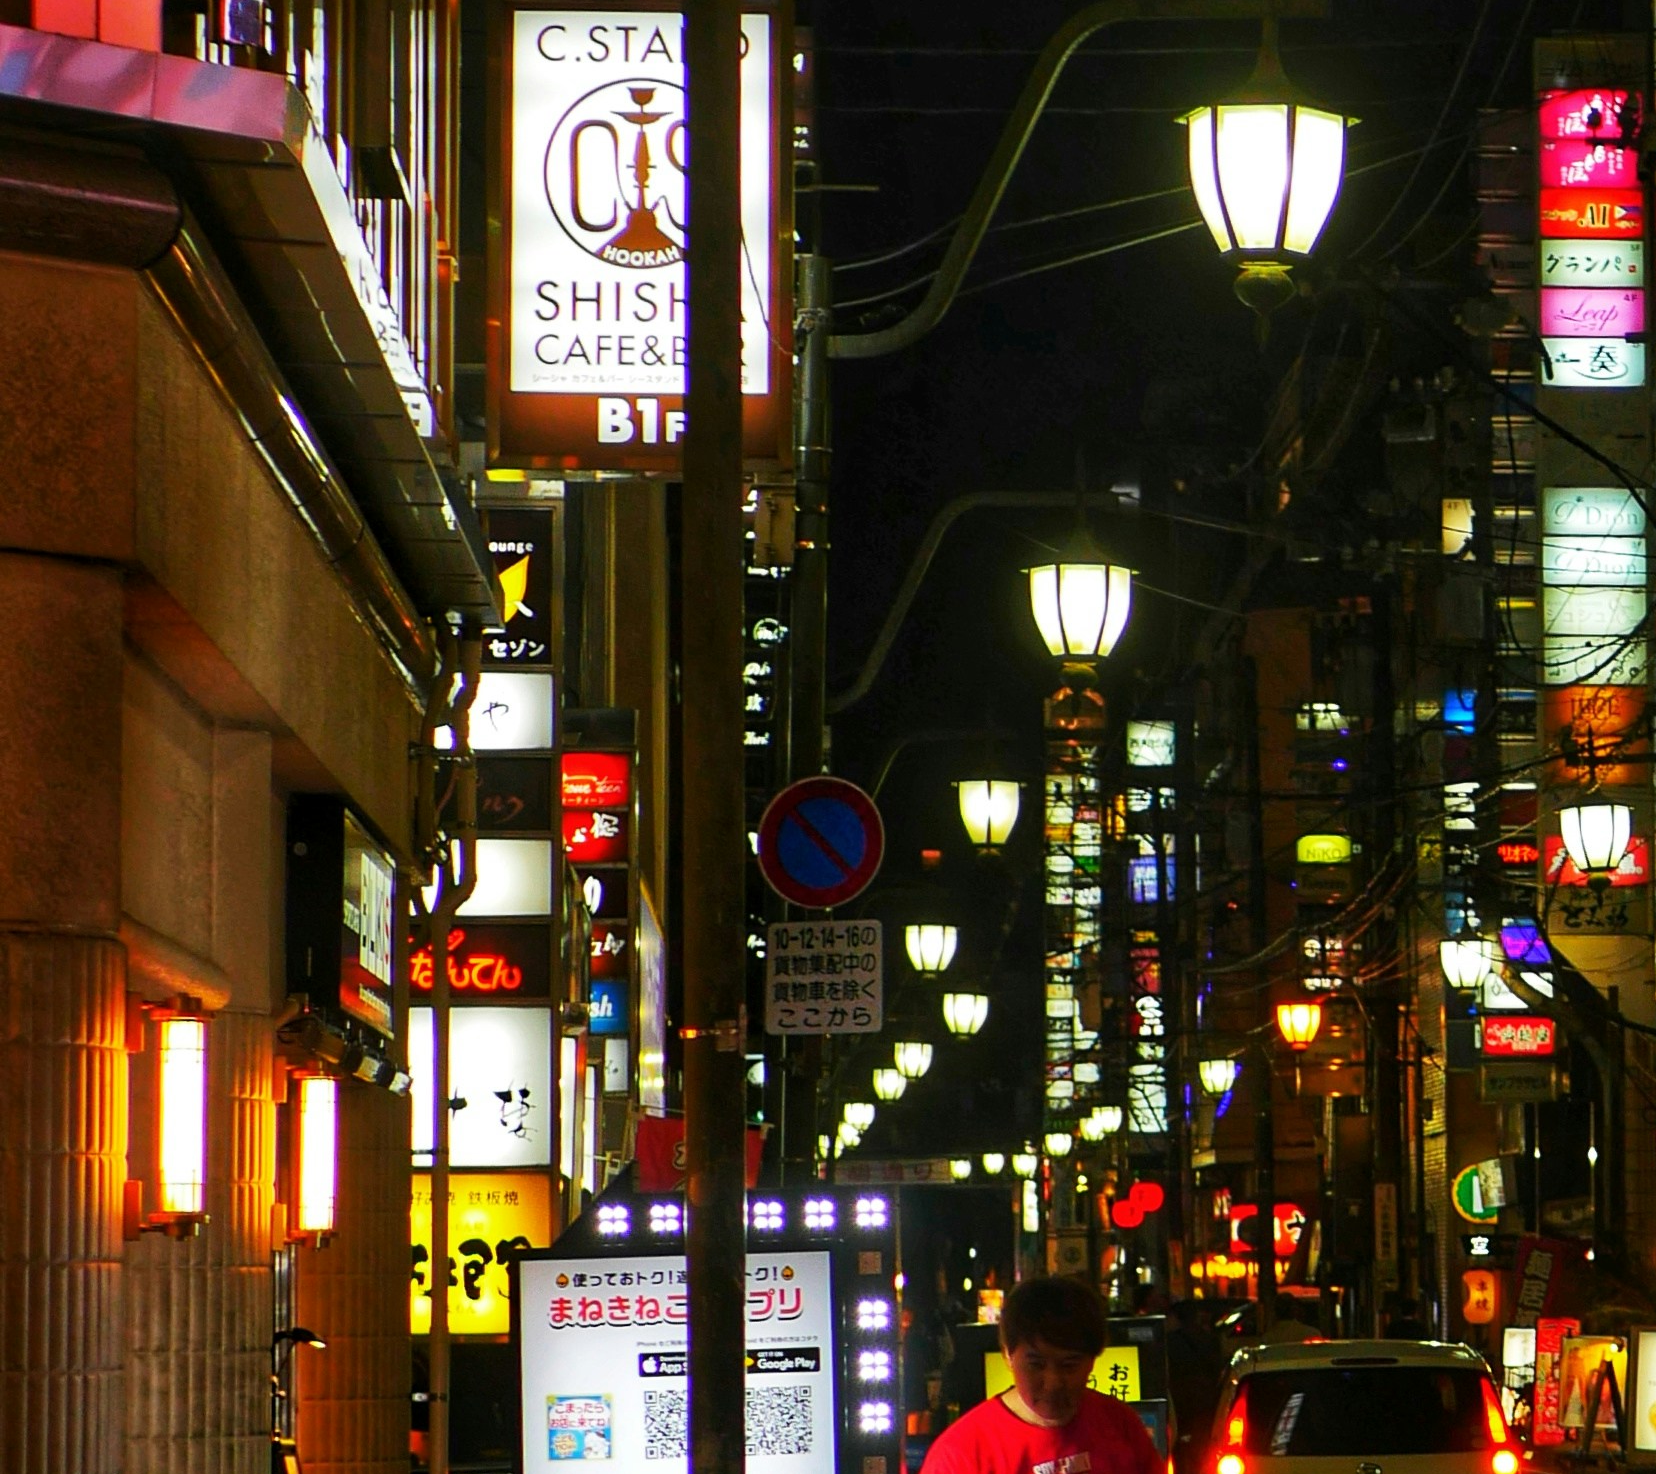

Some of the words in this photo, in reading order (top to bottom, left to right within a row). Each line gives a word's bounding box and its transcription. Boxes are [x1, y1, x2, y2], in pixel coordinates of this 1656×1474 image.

[537, 25, 749, 64] C.STA
[602, 244, 681, 268] HOOKAH
[1547, 254, 1622, 274] グランパ
[489, 639, 545, 658] セゾン
[778, 1007, 872, 1028] ここから
[549, 1287, 803, 1328] まねきねこプリ
[659, 1362, 682, 1375] App
[757, 1357, 794, 1371] Google
[795, 1357, 816, 1370] Play
